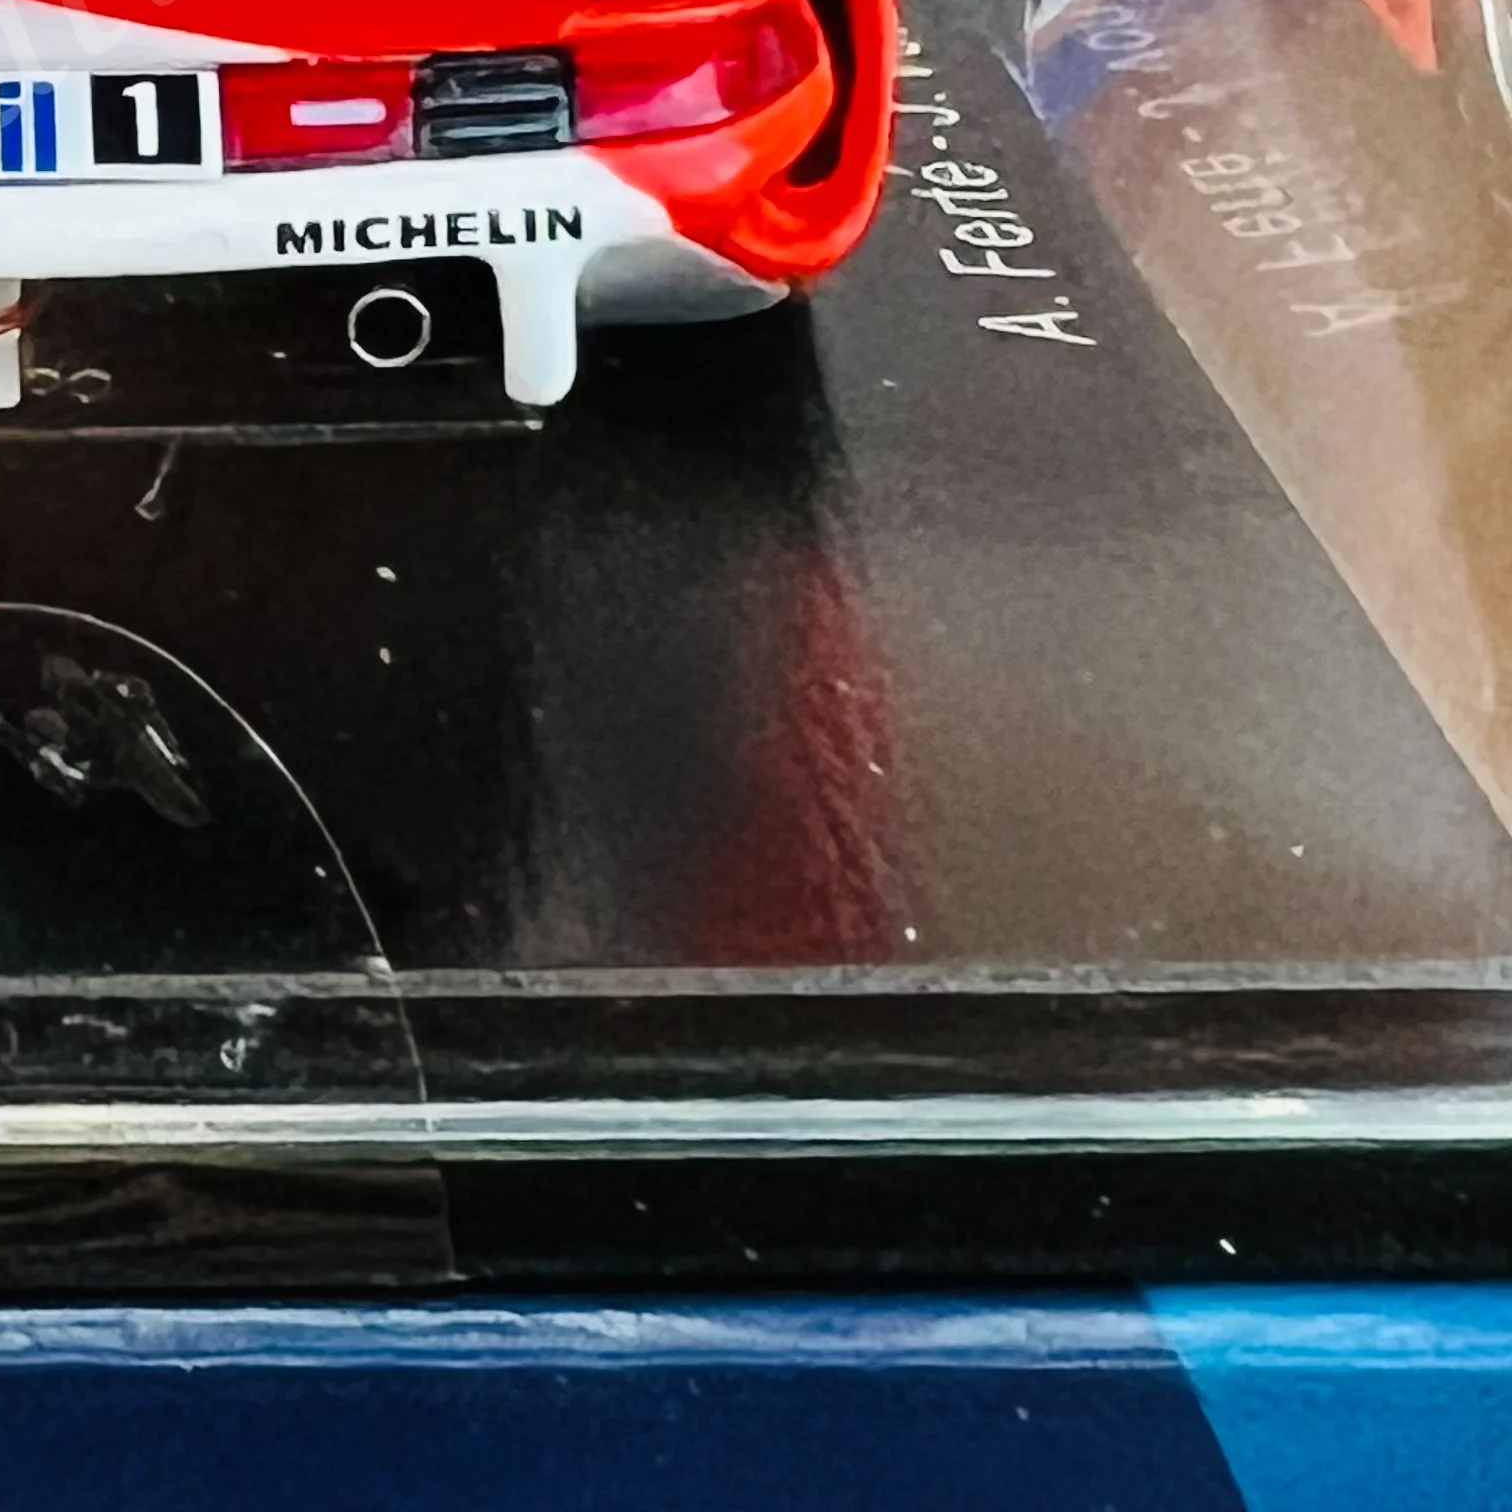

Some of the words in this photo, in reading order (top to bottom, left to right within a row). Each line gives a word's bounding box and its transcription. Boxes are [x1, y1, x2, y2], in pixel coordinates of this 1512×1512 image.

[120, 80, 161, 159] 1
[275, 205, 584, 256] MICHELIN
[977, 295, 1097, 346] A.
